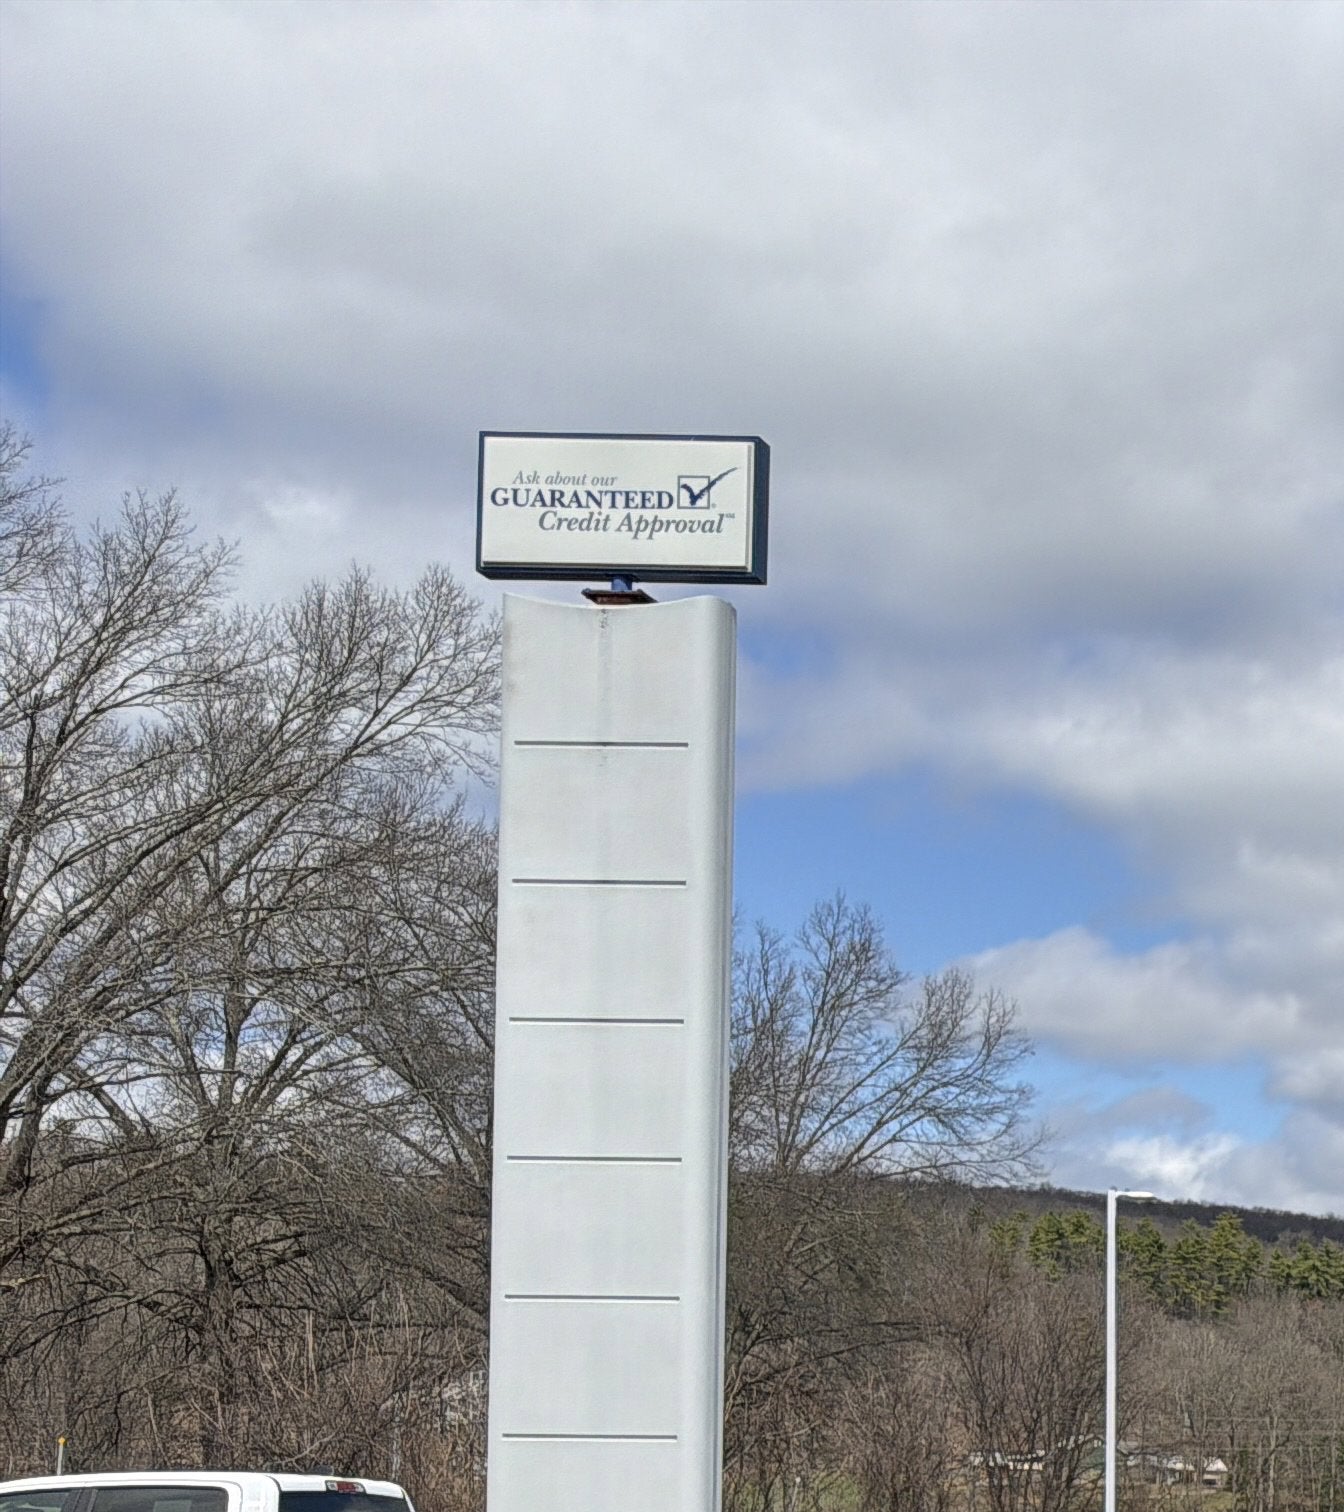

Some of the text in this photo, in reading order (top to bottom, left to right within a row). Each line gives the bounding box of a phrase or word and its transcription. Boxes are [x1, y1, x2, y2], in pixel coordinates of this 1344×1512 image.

[512, 470, 618, 487] Ask about our
[490, 488, 674, 510] GUARANTEED
[538, 510, 724, 540] Credit Approval
